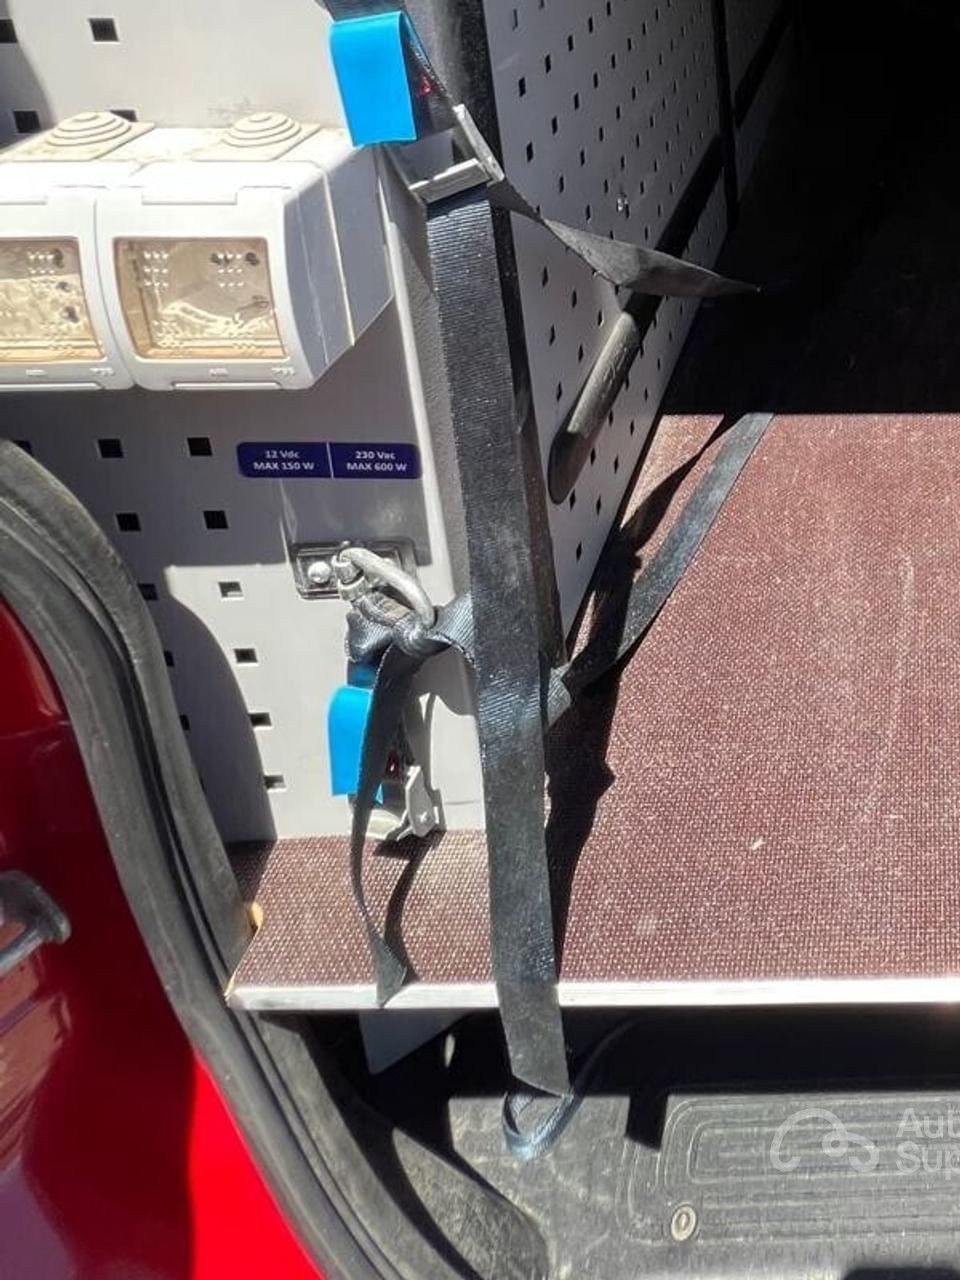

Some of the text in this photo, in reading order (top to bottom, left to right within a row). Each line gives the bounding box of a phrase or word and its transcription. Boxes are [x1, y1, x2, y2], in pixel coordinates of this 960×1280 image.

[265, 450, 278, 459] 12
[355, 450, 396, 460] 230 Vac
[253, 461, 315, 471] MAX 150 W
[346, 462, 408, 472] MAX 600 W
